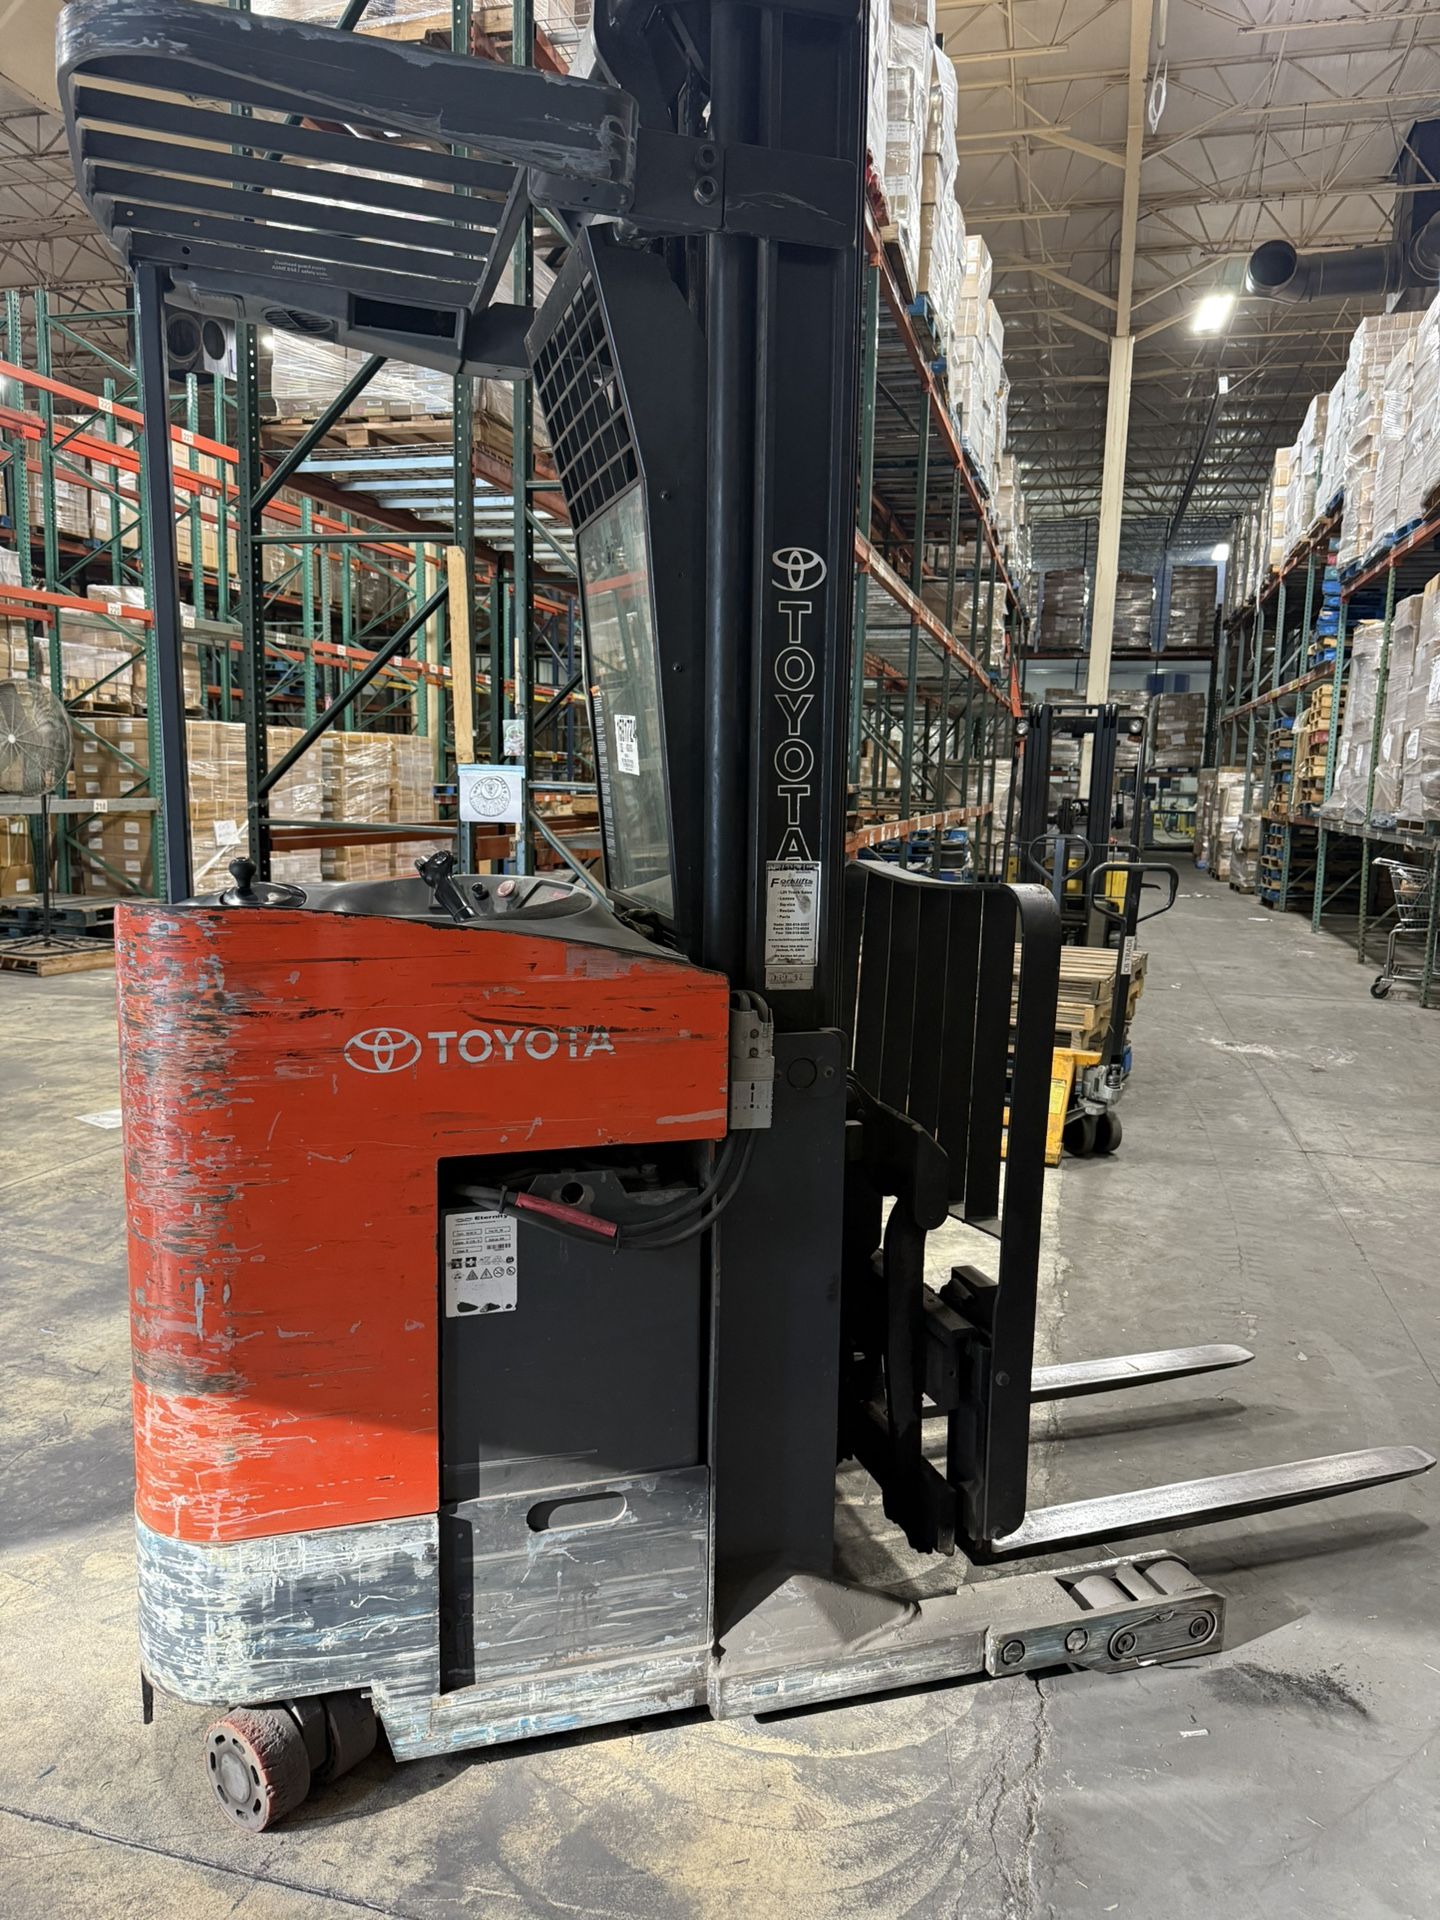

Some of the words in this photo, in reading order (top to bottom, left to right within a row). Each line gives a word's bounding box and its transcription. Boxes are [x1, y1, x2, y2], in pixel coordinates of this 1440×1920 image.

[774, 600, 815, 861] TOYOTA
[770, 878, 814, 888] Forklifts
[427, 1027, 617, 1064] TOYOTA
